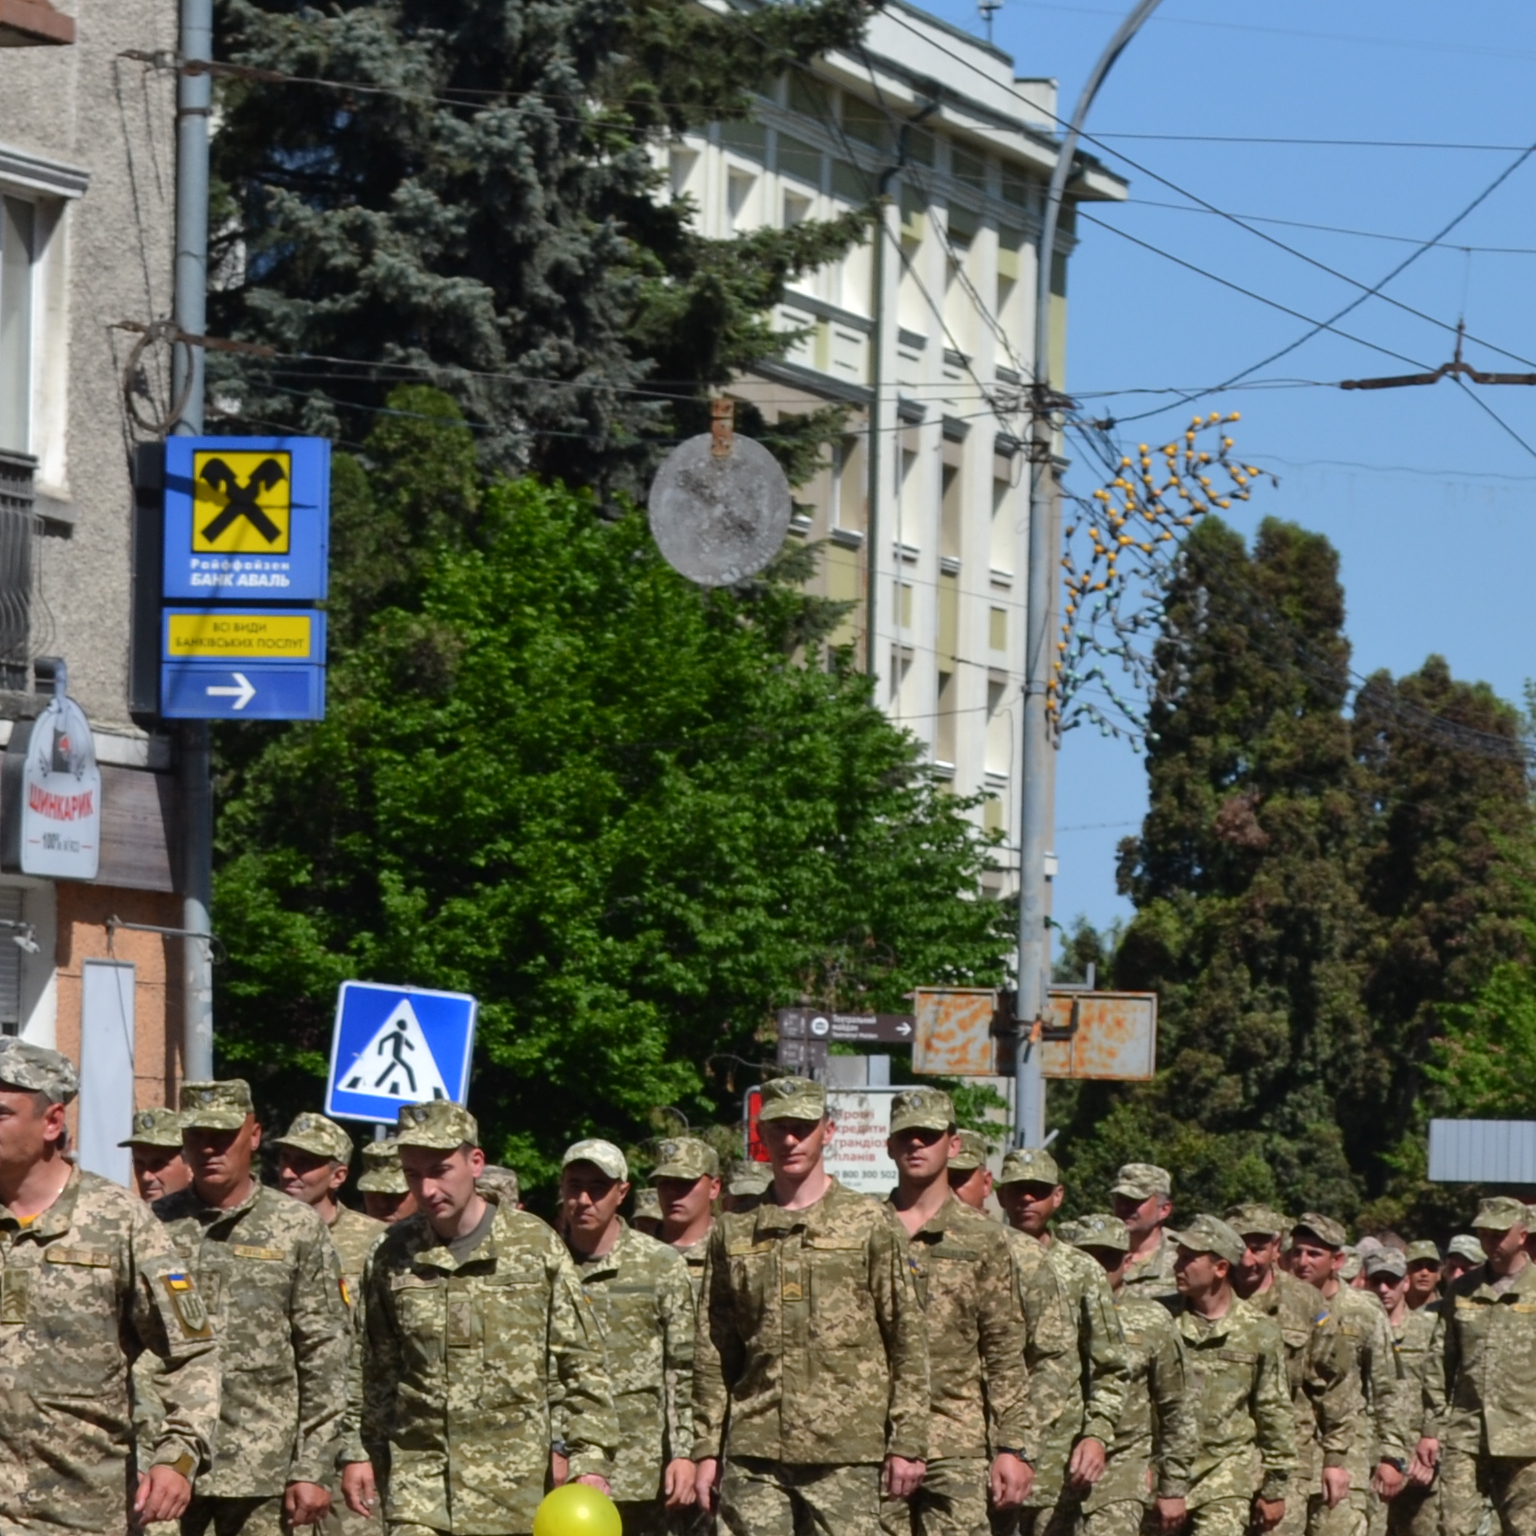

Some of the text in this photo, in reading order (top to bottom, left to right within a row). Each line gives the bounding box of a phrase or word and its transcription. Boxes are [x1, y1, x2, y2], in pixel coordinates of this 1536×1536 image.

[190, 573, 291, 588] БАНК АВАЛЬ
[233, 623, 267, 634] ВИДИ
[176, 637, 305, 650] БАНКІВСЬКИХ ПОСЛУГ
[29, 781, 94, 821] ШИНКАРИК
[842, 1170, 859, 1179] 800
[861, 1170, 878, 1179] 300
[880, 1170, 897, 1179] 502
